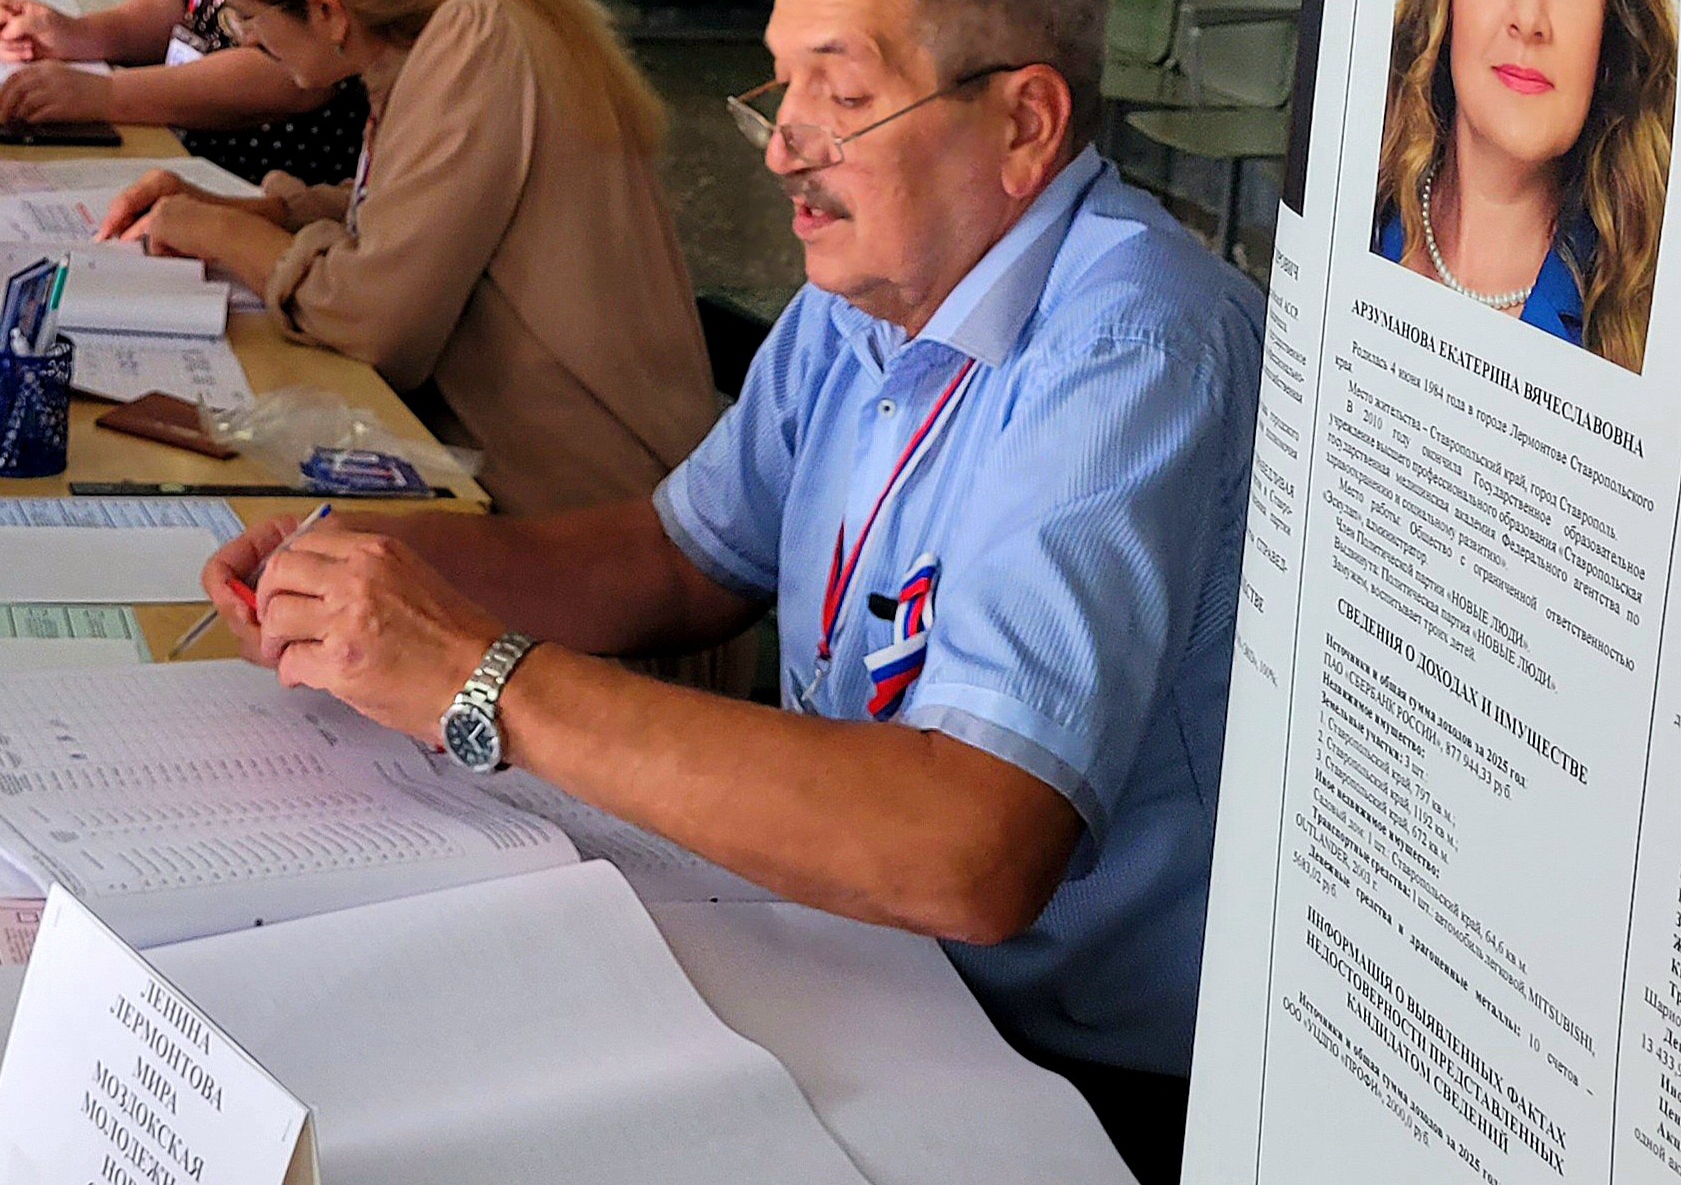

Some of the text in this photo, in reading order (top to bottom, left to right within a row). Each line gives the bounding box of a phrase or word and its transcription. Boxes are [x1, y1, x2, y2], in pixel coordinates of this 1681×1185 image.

[1345, 398, 1353, 413] В
[1350, 299, 1436, 353] АРЗУМАНОВА
[1438, 339, 1520, 395] ЕКАТЕРИНА
[1523, 381, 1644, 459] ВЯЧЕСЛАВОВНА
[1569, 454, 1655, 512] Ставропольского
[1544, 607, 1635, 672] ответственностью
[1337, 597, 1588, 785] СВЕДЕНИЯ О ДОХОДАХ И ИМУЩЕСТВЕ
[1485, 747, 1509, 774] 2025
[109, 993, 223, 1113] ЛЕРМОНТОВА
[140, 978, 210, 1056] ЛЕНИНА
[1305, 928, 1564, 1176] НЕДОСТОВЕРНОСТИ ПРЕДСТАВЛЕННЫХ
[1306, 904, 1566, 1151] ИНФОРМАЦИЯ О ВЫЯВЛЕННЫХ ФАКТАХ
[1528, 986, 1596, 1057] MITSUBISHI,
[1528, 1032, 1541, 1053] 10
[131, 1054, 178, 1116] МИРА
[1346, 991, 1508, 1155] КАНДИДАТОМ СВЕДЕНИЙ
[91, 1059, 205, 1183] МОЗДОКСКАЯ
[1457, 1143, 1480, 1173] 2025
